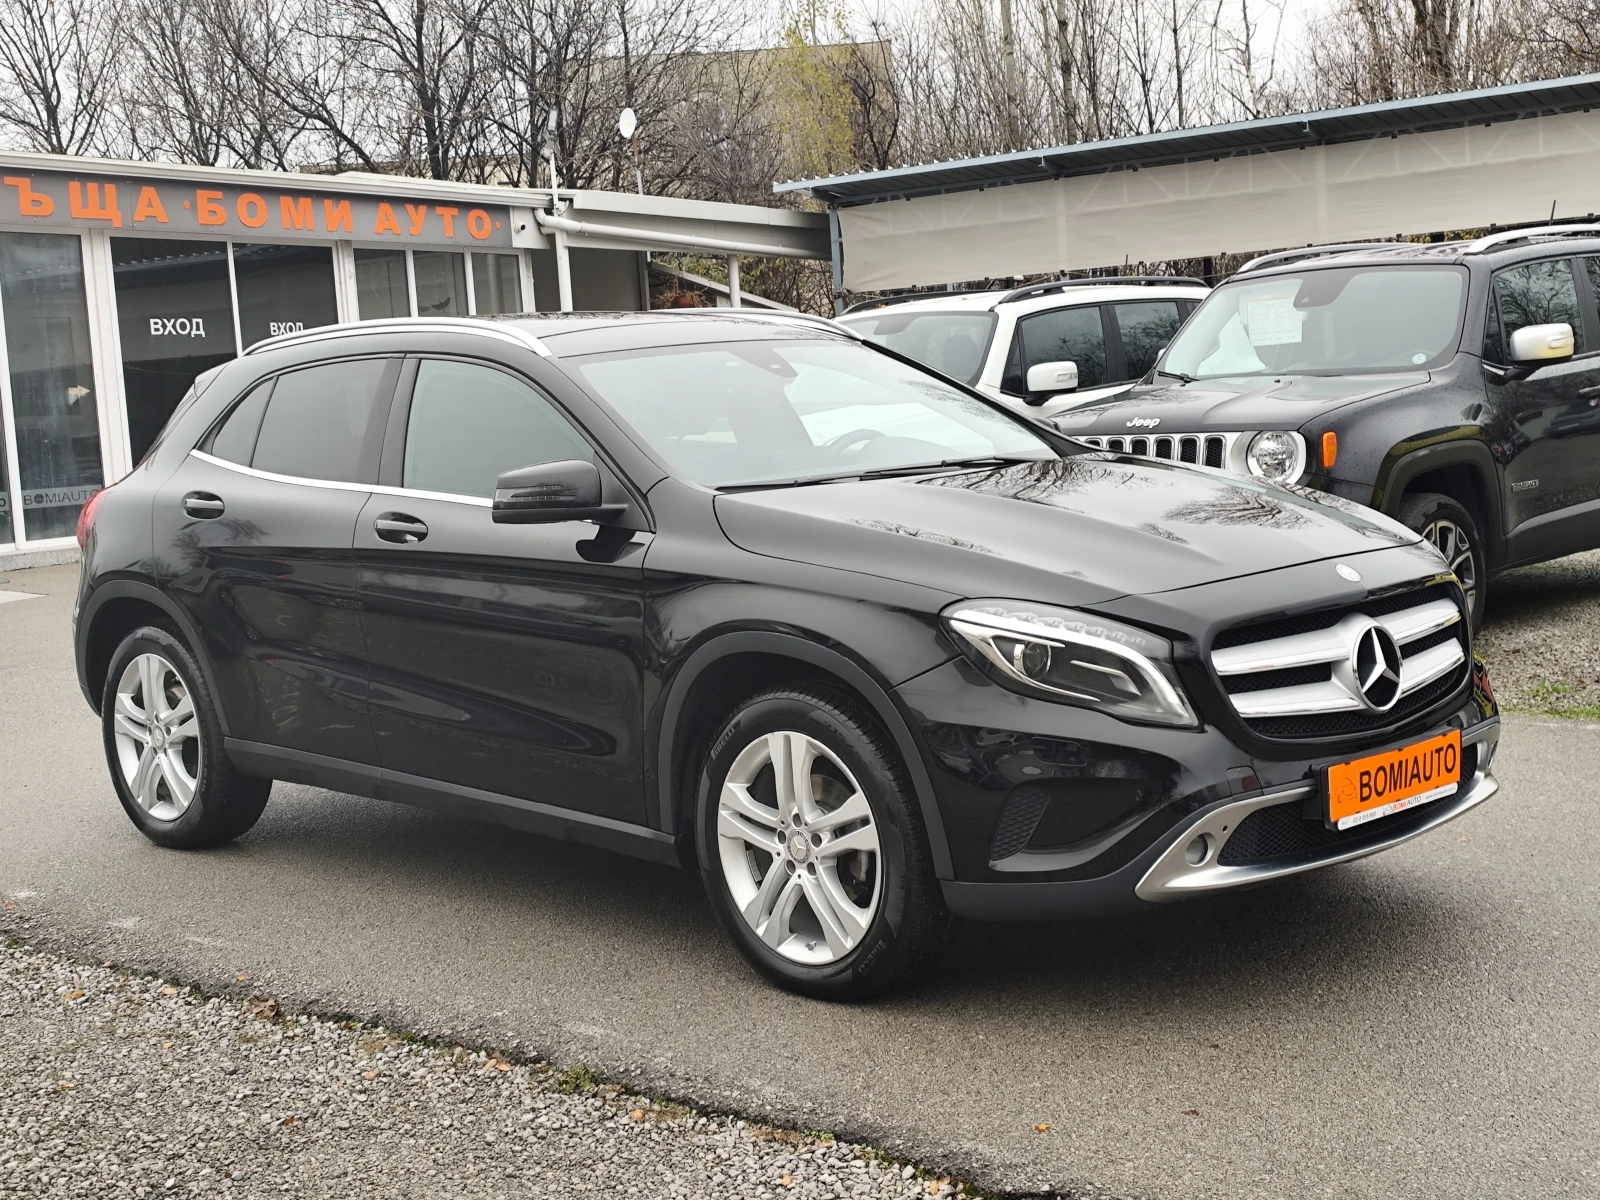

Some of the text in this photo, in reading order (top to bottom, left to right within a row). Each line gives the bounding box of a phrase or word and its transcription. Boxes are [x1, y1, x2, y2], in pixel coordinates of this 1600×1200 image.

[196, 190, 353, 232] БОМИ
[375, 203, 492, 240] АУТО
[150, 319, 205, 337] ВХОД
[1126, 417, 1160, 429] Jeep
[1359, 743, 1456, 803] BOMIAUTO
[1392, 801, 1406, 811] BOMI
[1407, 795, 1421, 806] AUTO
